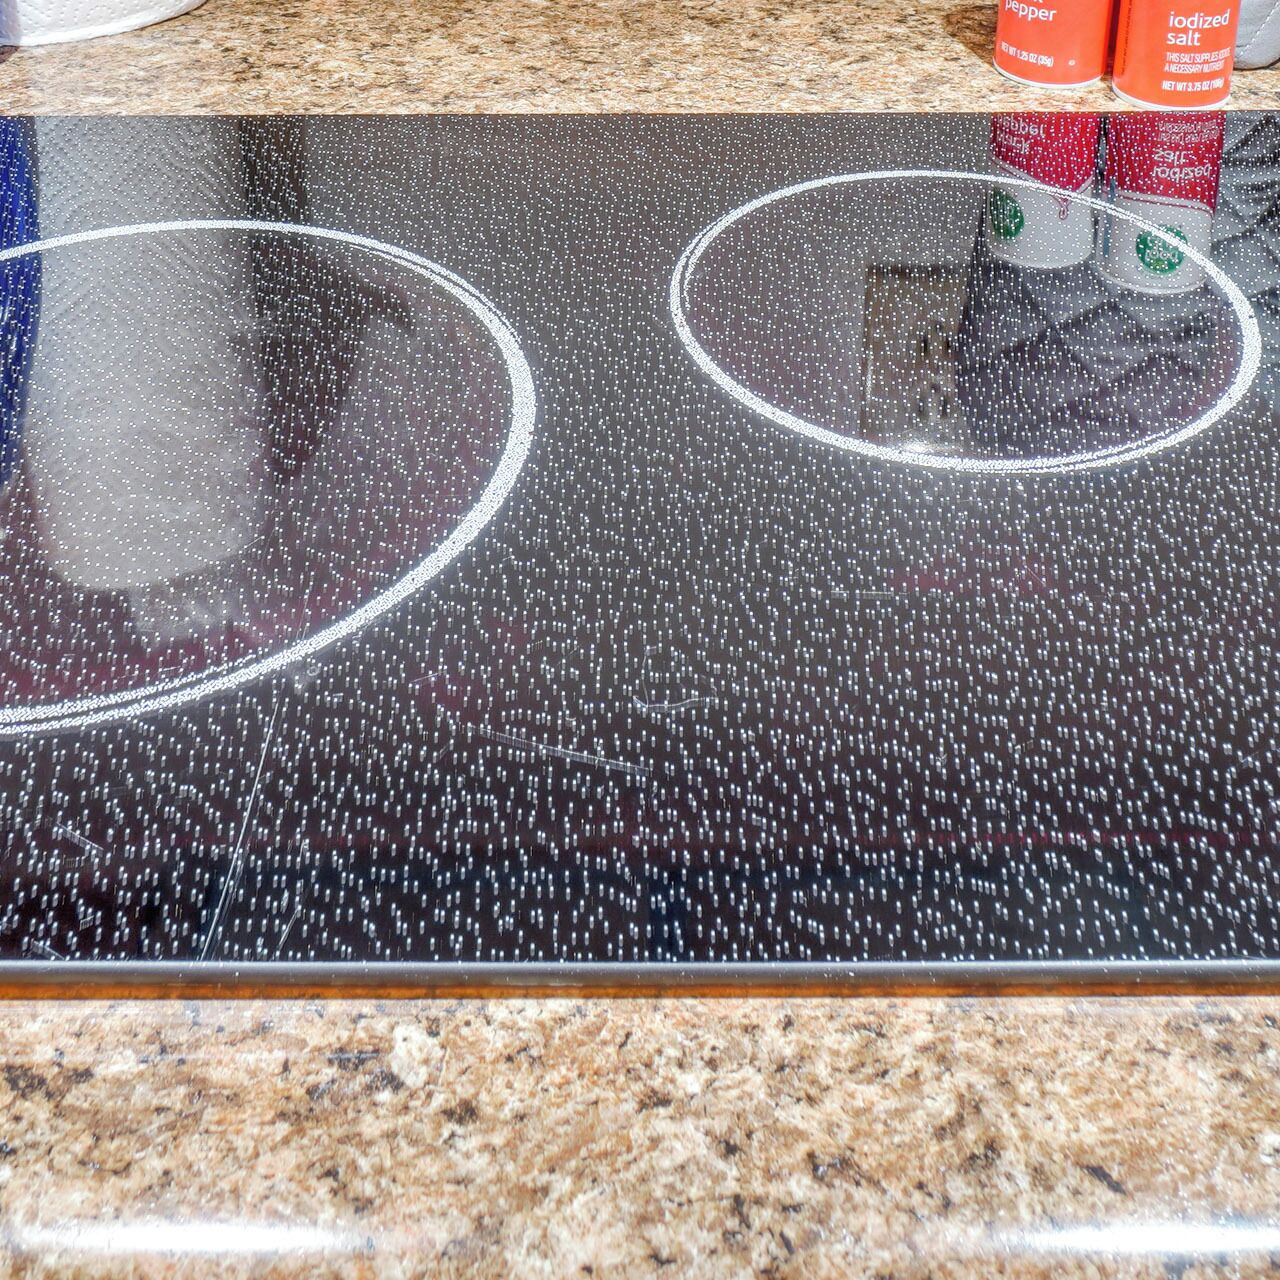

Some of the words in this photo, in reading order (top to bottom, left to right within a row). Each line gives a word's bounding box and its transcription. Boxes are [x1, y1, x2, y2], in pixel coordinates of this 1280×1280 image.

[1168, 9, 1231, 29] iodized
[1166, 30, 1200, 46] salt
[1009, 46, 1017, 56] WT
[1029, 53, 1037, 63] OZ
[1166, 52, 1179, 61] THIS
[1179, 53, 1194, 62] SALT
[1162, 80, 1175, 90] NET
[1176, 81, 1187, 91] WT
[1201, 80, 1210, 90] OZ
